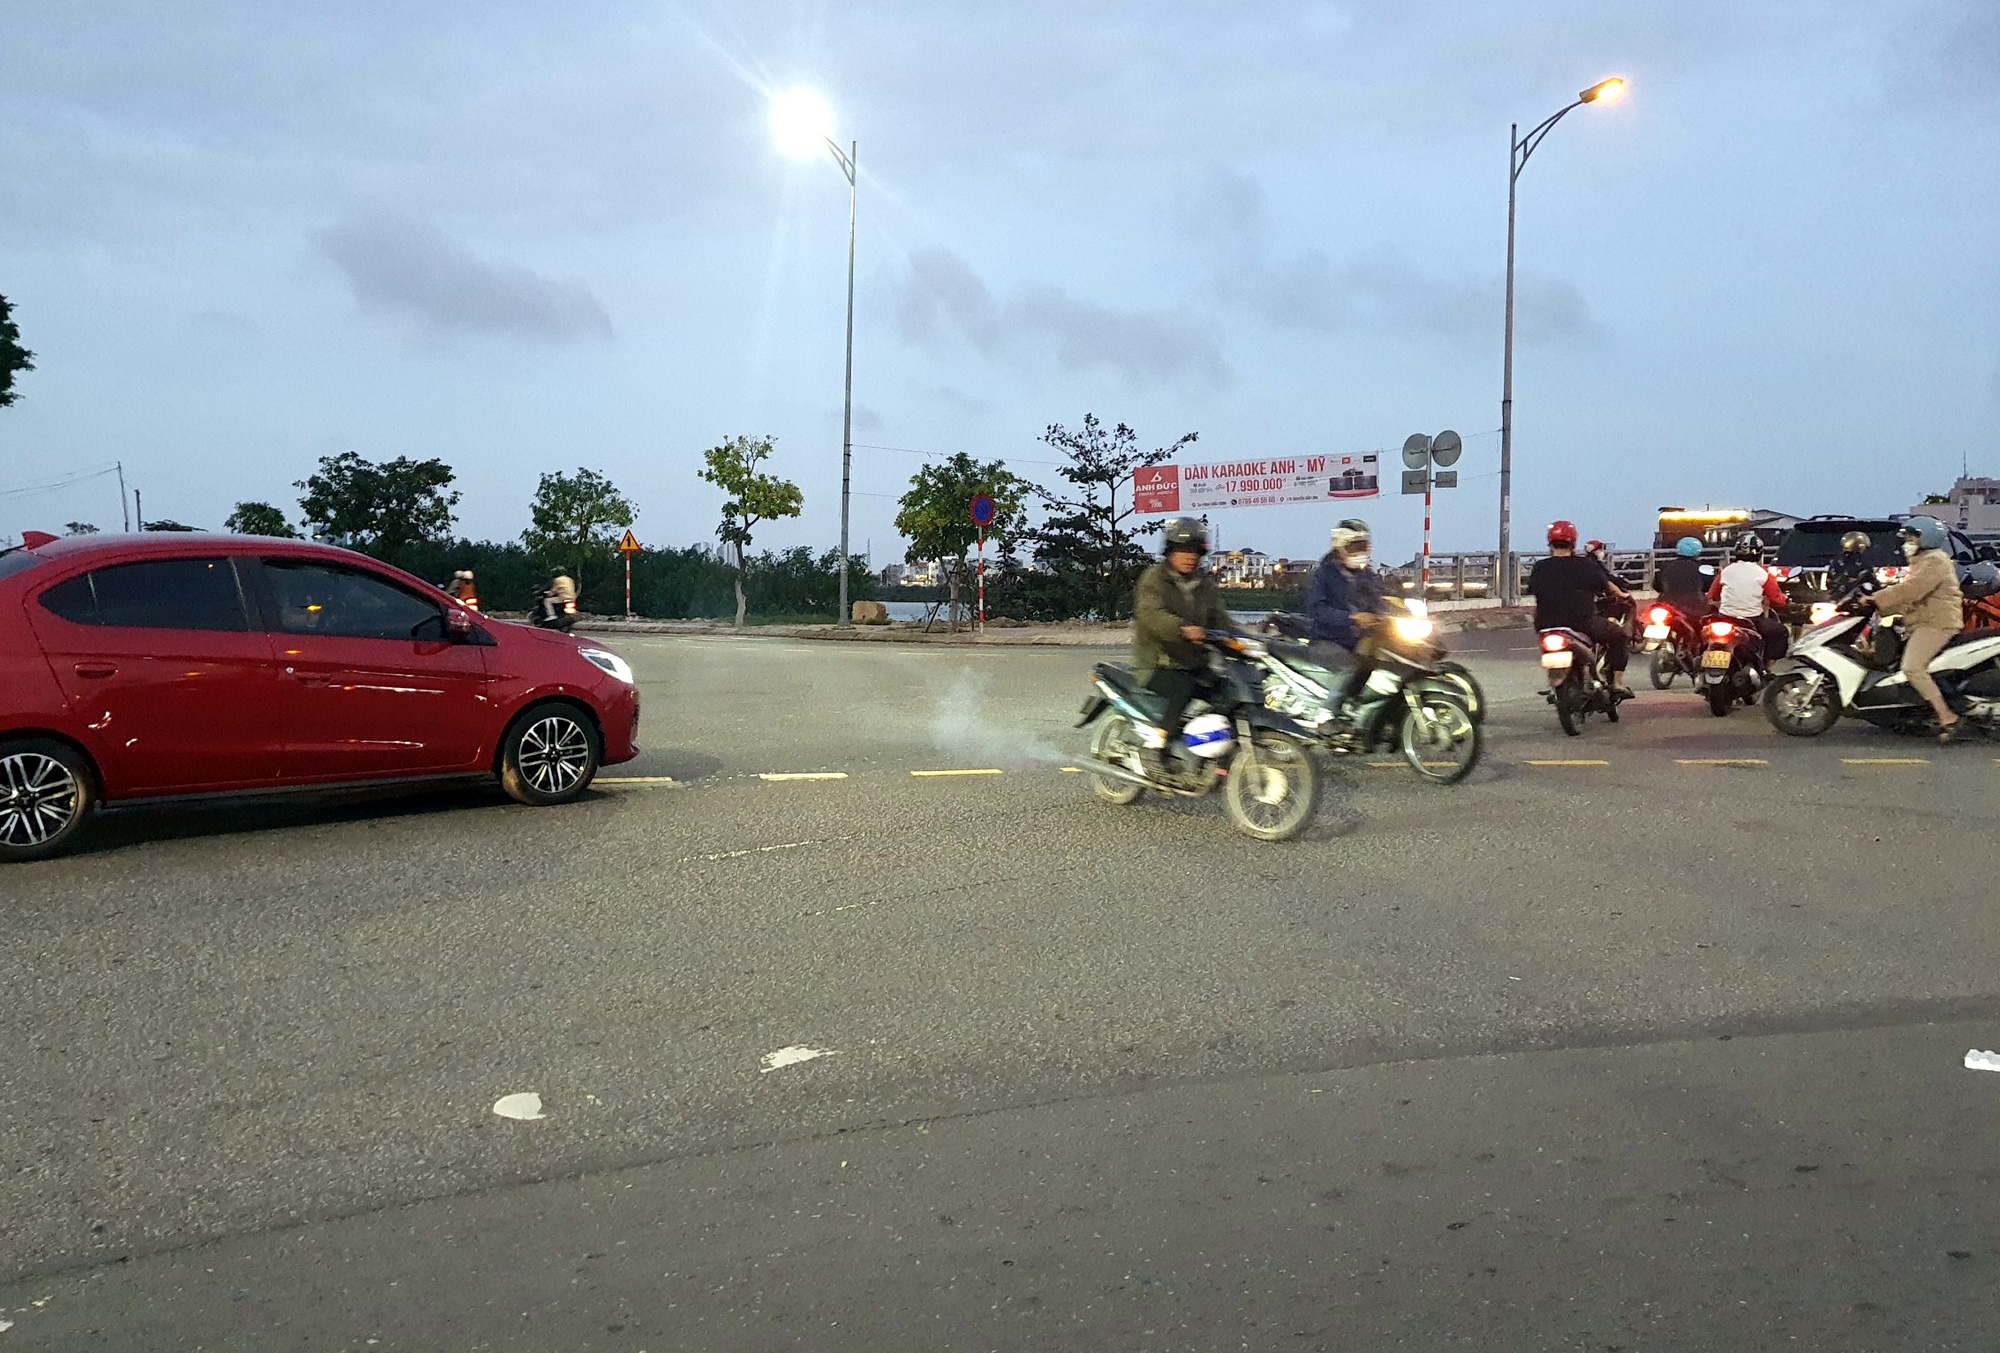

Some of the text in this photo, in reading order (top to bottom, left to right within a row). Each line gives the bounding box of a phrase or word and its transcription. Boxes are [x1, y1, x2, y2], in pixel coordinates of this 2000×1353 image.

[1211, 462, 1267, 478] KARAOKE
[1270, 460, 1295, 474] ANH
[1307, 456, 1326, 472] MỸ
[1135, 484, 1155, 492] ANH
